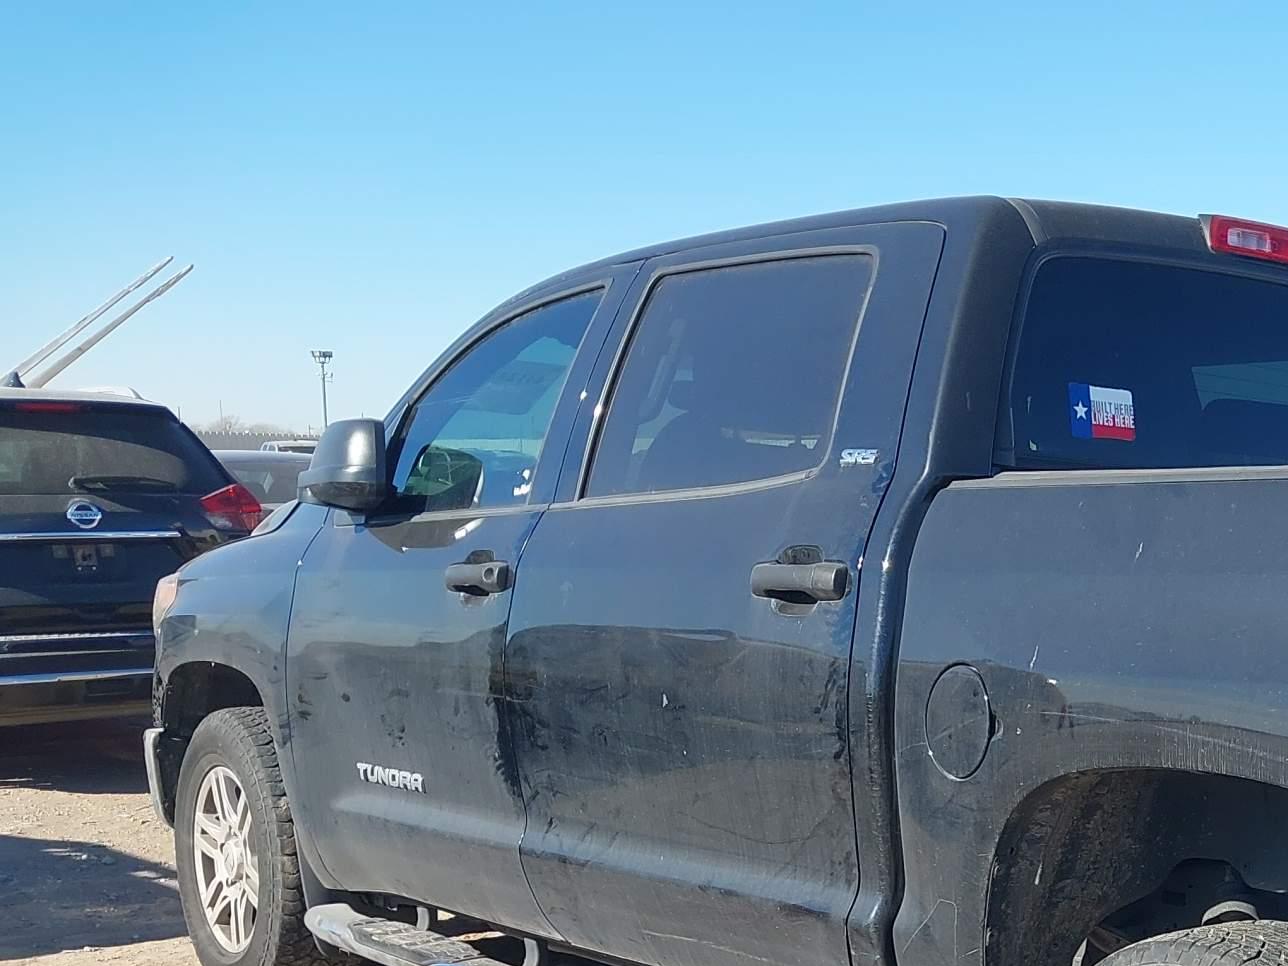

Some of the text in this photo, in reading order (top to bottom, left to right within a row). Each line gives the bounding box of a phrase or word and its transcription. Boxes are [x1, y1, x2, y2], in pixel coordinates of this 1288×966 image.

[1091, 400, 1133, 416] BUILT HERE
[1091, 411, 1136, 429] LIVES HERE
[356, 762, 424, 793] TUNDRA
